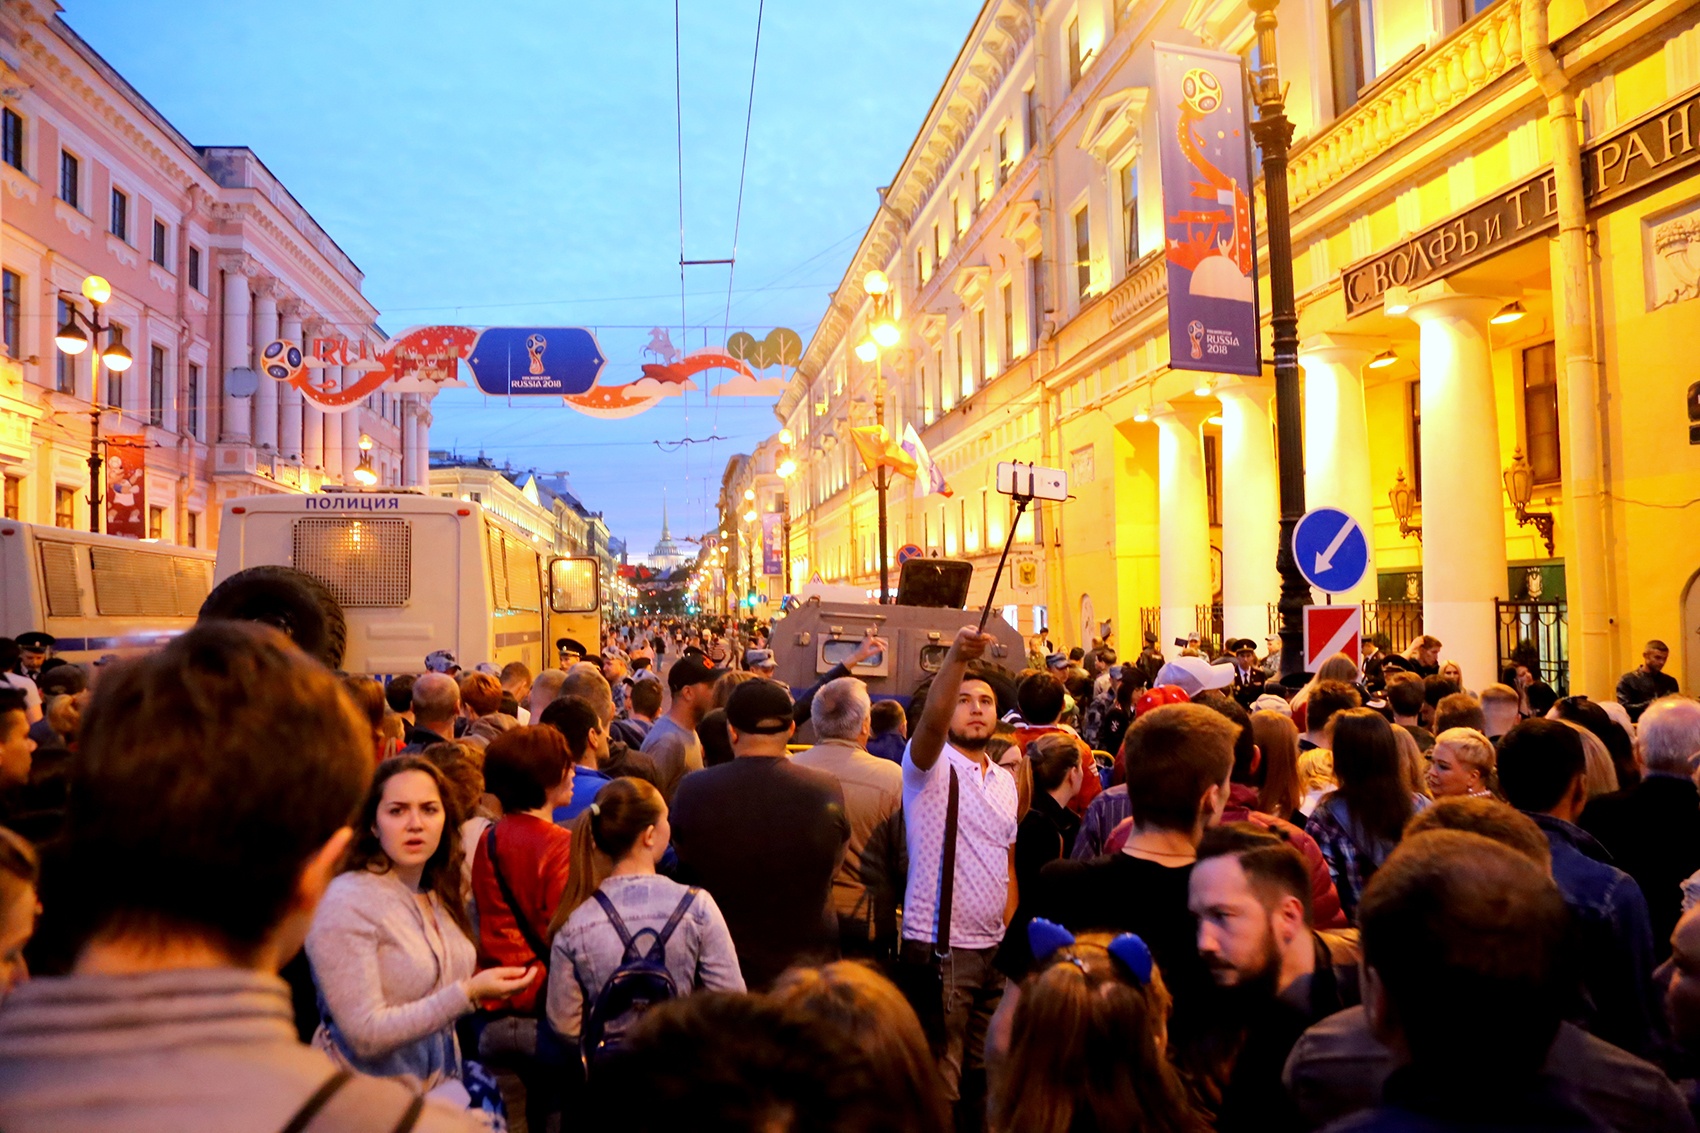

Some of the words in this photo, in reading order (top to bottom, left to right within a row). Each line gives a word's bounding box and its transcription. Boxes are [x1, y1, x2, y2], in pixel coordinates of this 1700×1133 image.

[1206, 334, 1240, 347] RUSSIA
[1206, 344, 1229, 355] 2018
[511, 380, 542, 388] RUSSIA
[543, 380, 562, 388] 2018
[306, 497, 399, 511] ПОЛИЦИЯ
